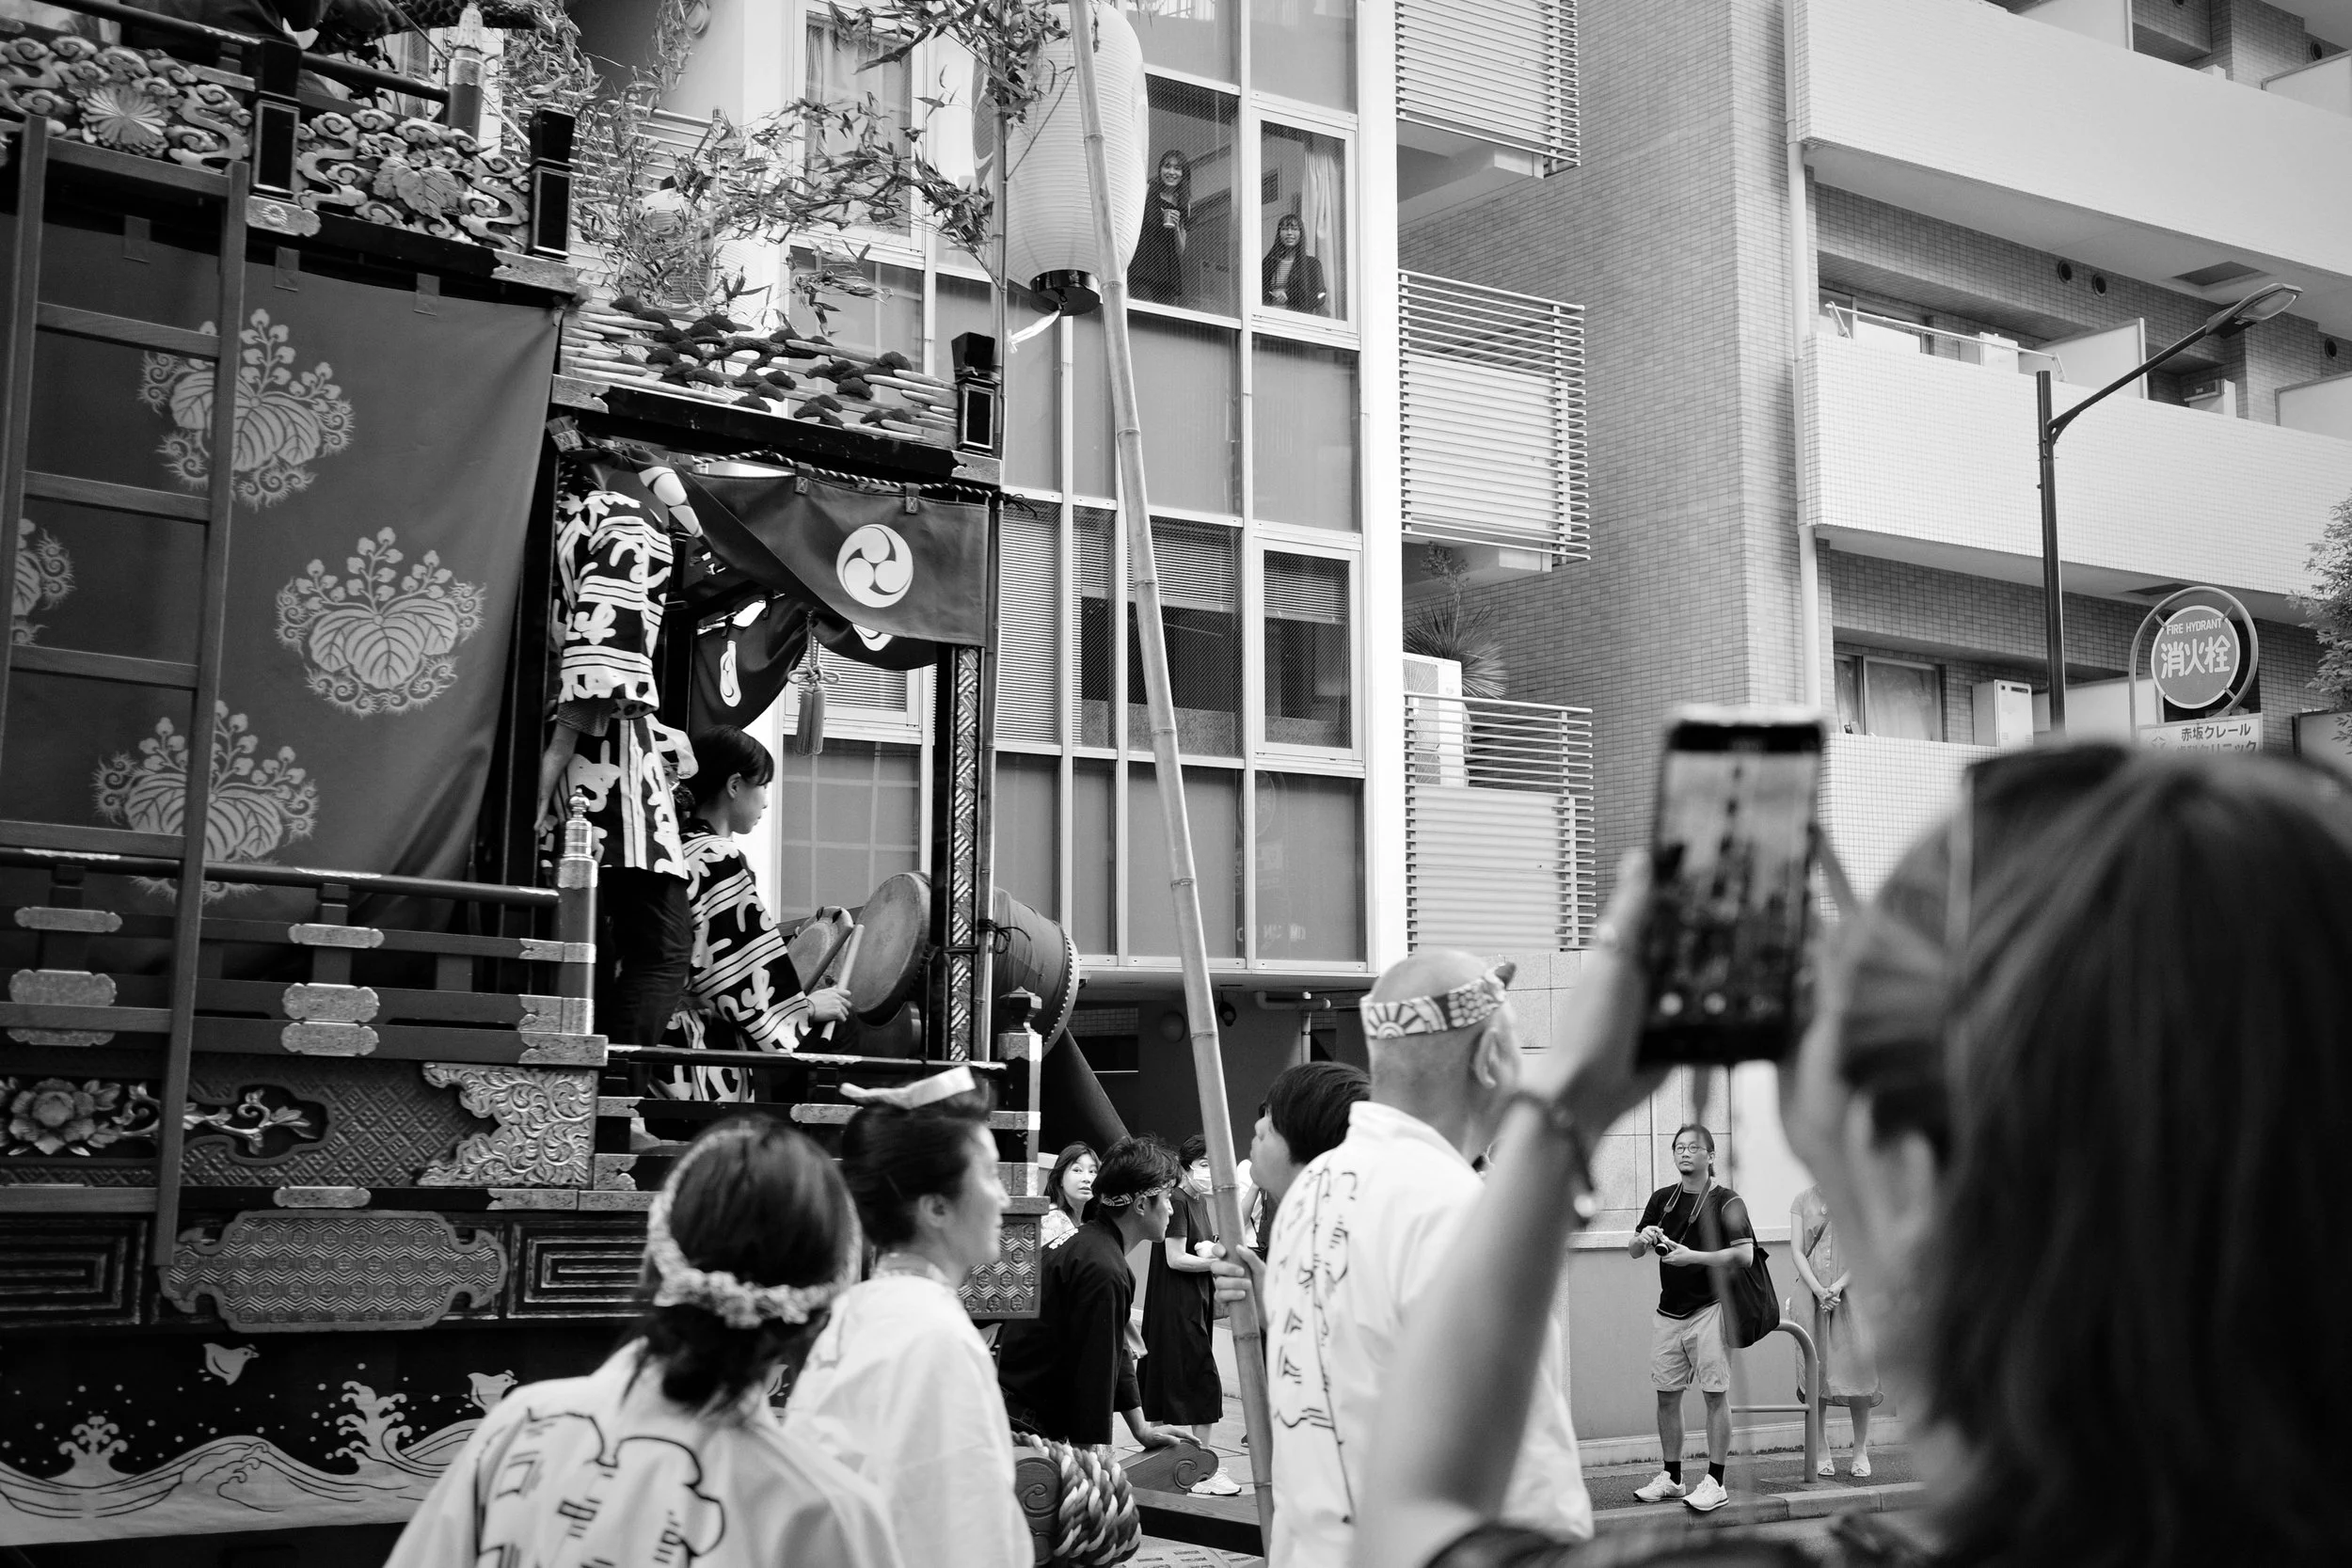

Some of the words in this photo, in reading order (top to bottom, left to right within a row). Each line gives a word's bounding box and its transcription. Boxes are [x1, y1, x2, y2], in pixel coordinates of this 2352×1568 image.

[2167, 623, 2184, 635] FIRE
[2185, 618, 2221, 633] HYDRANT
[2161, 635, 2231, 678] 消火栓
[2181, 723, 2251, 741] 赤坂クレール
